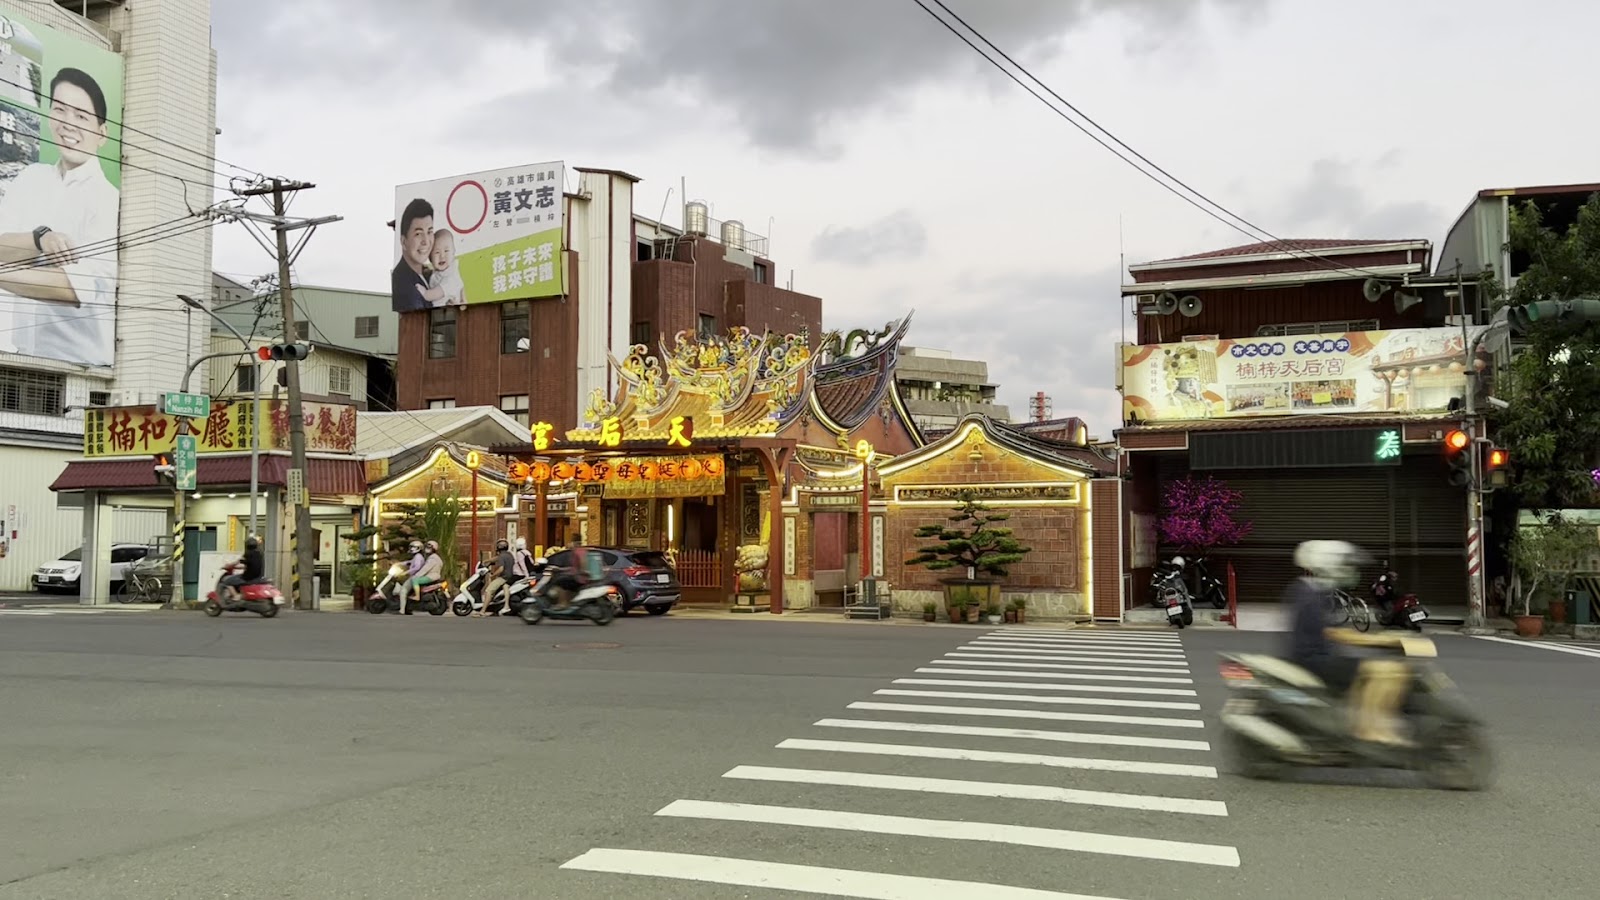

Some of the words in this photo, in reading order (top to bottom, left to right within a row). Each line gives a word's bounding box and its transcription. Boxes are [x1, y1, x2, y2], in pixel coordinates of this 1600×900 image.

[506, 170, 555, 186] 高雄市議員
[493, 185, 555, 215] 黃文志
[492, 242, 553, 274] 孩子未來
[492, 261, 554, 294] 我來守護
[1236, 358, 1345, 379] 楠梓天后宮
